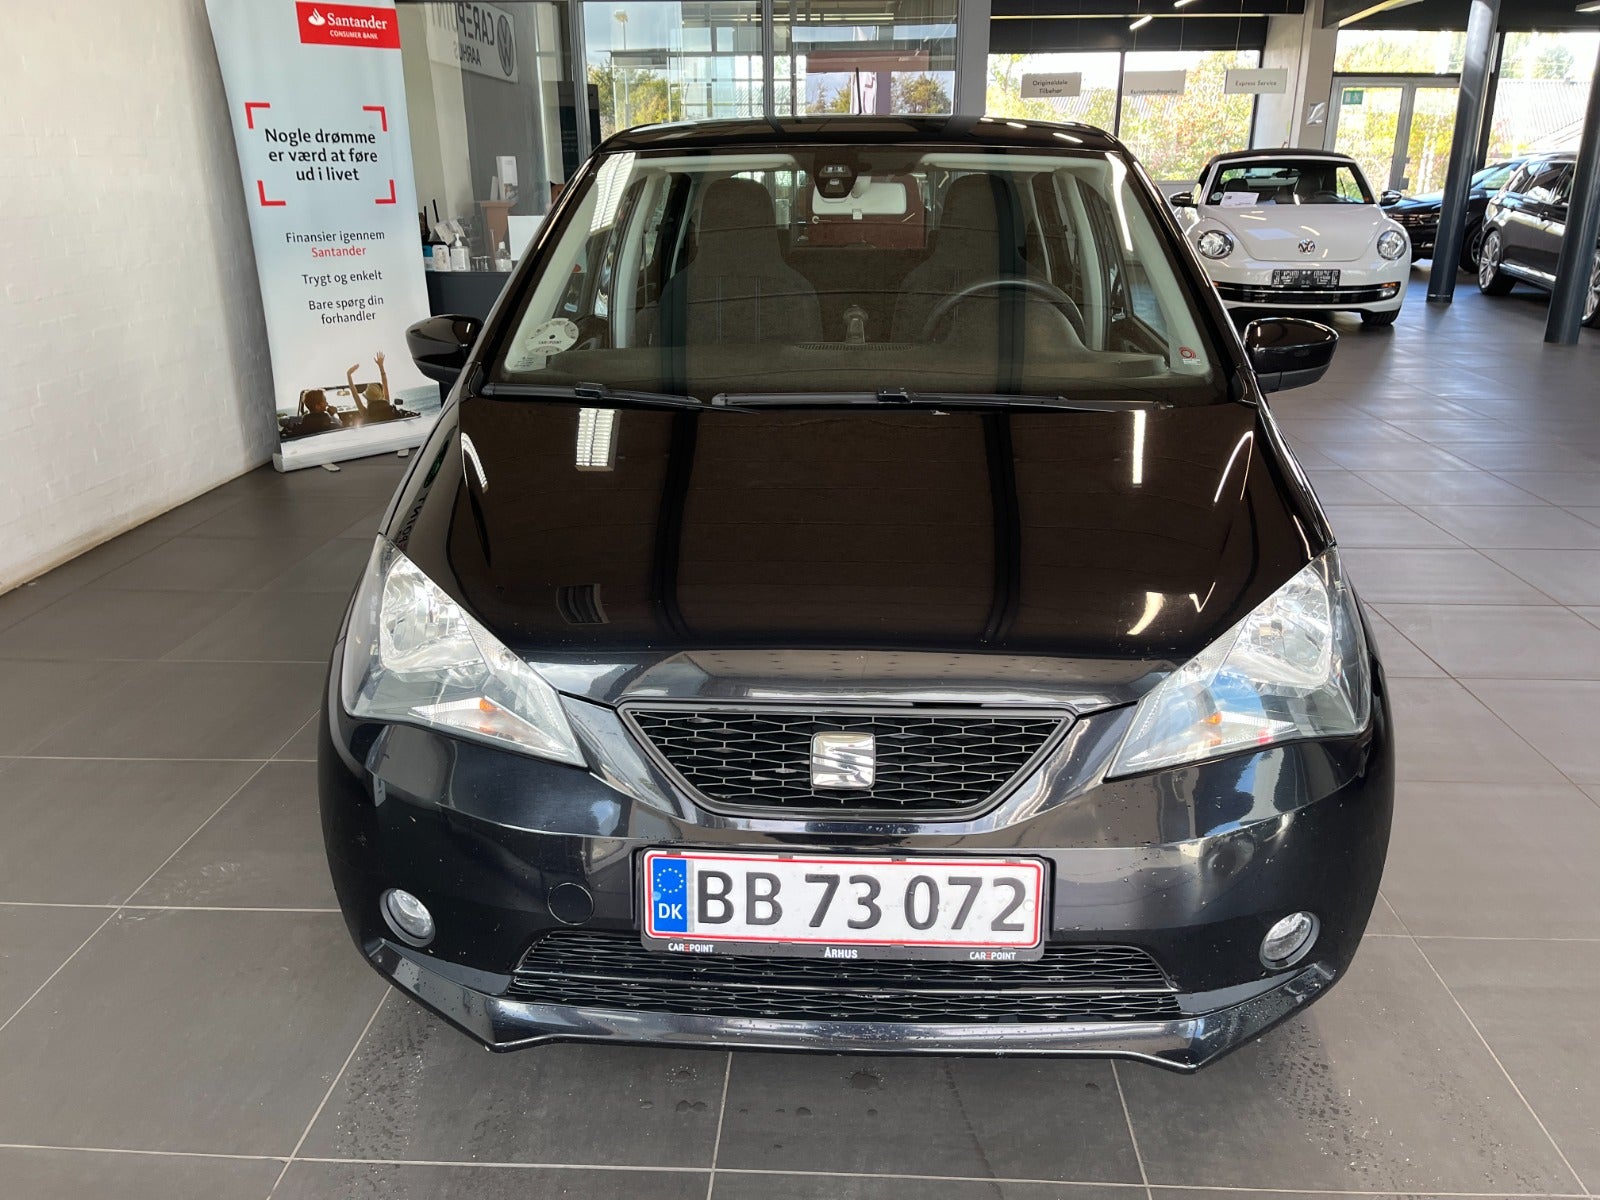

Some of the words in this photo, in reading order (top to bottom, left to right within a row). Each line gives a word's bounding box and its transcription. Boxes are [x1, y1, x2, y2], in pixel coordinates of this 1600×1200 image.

[327, 12, 388, 30] Santander
[329, 29, 361, 39] CONSUMER
[362, 31, 379, 40] BANK
[264, 128, 311, 147] Nogle
[315, 130, 376, 145] drømme
[268, 151, 284, 163] er
[288, 149, 327, 163] værd
[330, 150, 346, 163] at
[348, 148, 378, 163] føre
[296, 167, 315, 181] ud
[318, 168, 323, 181] i
[326, 167, 360, 181] livet
[285, 230, 337, 243] Finansier
[339, 230, 385, 244] igennem
[311, 246, 366, 258] Santander
[301, 272, 332, 287] Trygt
[334, 274, 348, 285] og
[350, 270, 383, 282] enkelt
[308, 300, 333, 311] Bare
[335, 297, 366, 311] spørg
[367, 295, 384, 306] din
[320, 310, 376, 325] forhandler
[658, 902, 684, 921] DK
[697, 869, 784, 926] BB
[804, 873, 884, 931] 73
[903, 873, 1028, 933] 072
